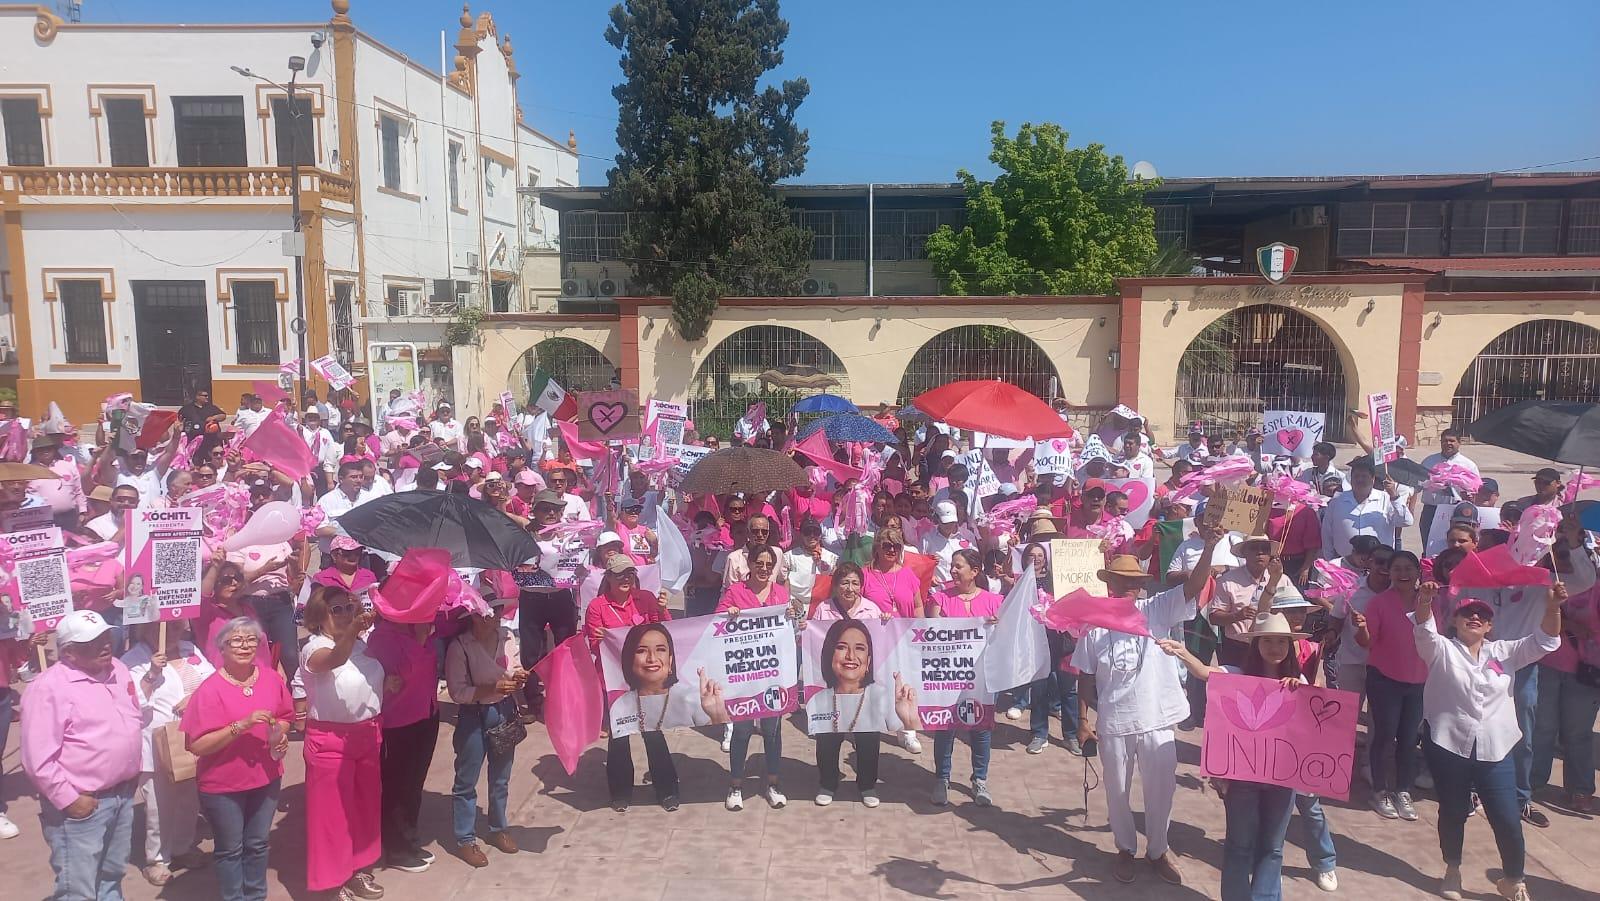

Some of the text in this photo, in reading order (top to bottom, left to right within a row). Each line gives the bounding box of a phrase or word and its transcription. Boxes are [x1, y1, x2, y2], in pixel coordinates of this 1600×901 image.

[1262, 414, 1324, 441] ESPERANZA
[142, 510, 191, 521] XÓCHITL
[30, 604, 65, 614] DEFENDER
[724, 632, 775, 644] PRESIDENTA
[912, 627, 983, 642] XÓCHITL
[724, 645, 777, 661] POR UN
[725, 657, 779, 674] MÉXICO
[922, 657, 974, 668] POR UN
[728, 669, 779, 684] SIN MIEDO
[922, 668, 975, 681] MÉXICO
[923, 682, 974, 691] SIN MIEDO
[765, 689, 786, 704] PRI
[727, 699, 760, 716] VOTA
[959, 702, 980, 718] PRI
[921, 709, 953, 725] VOTA
[1205, 731, 1351, 794] UNID@S
